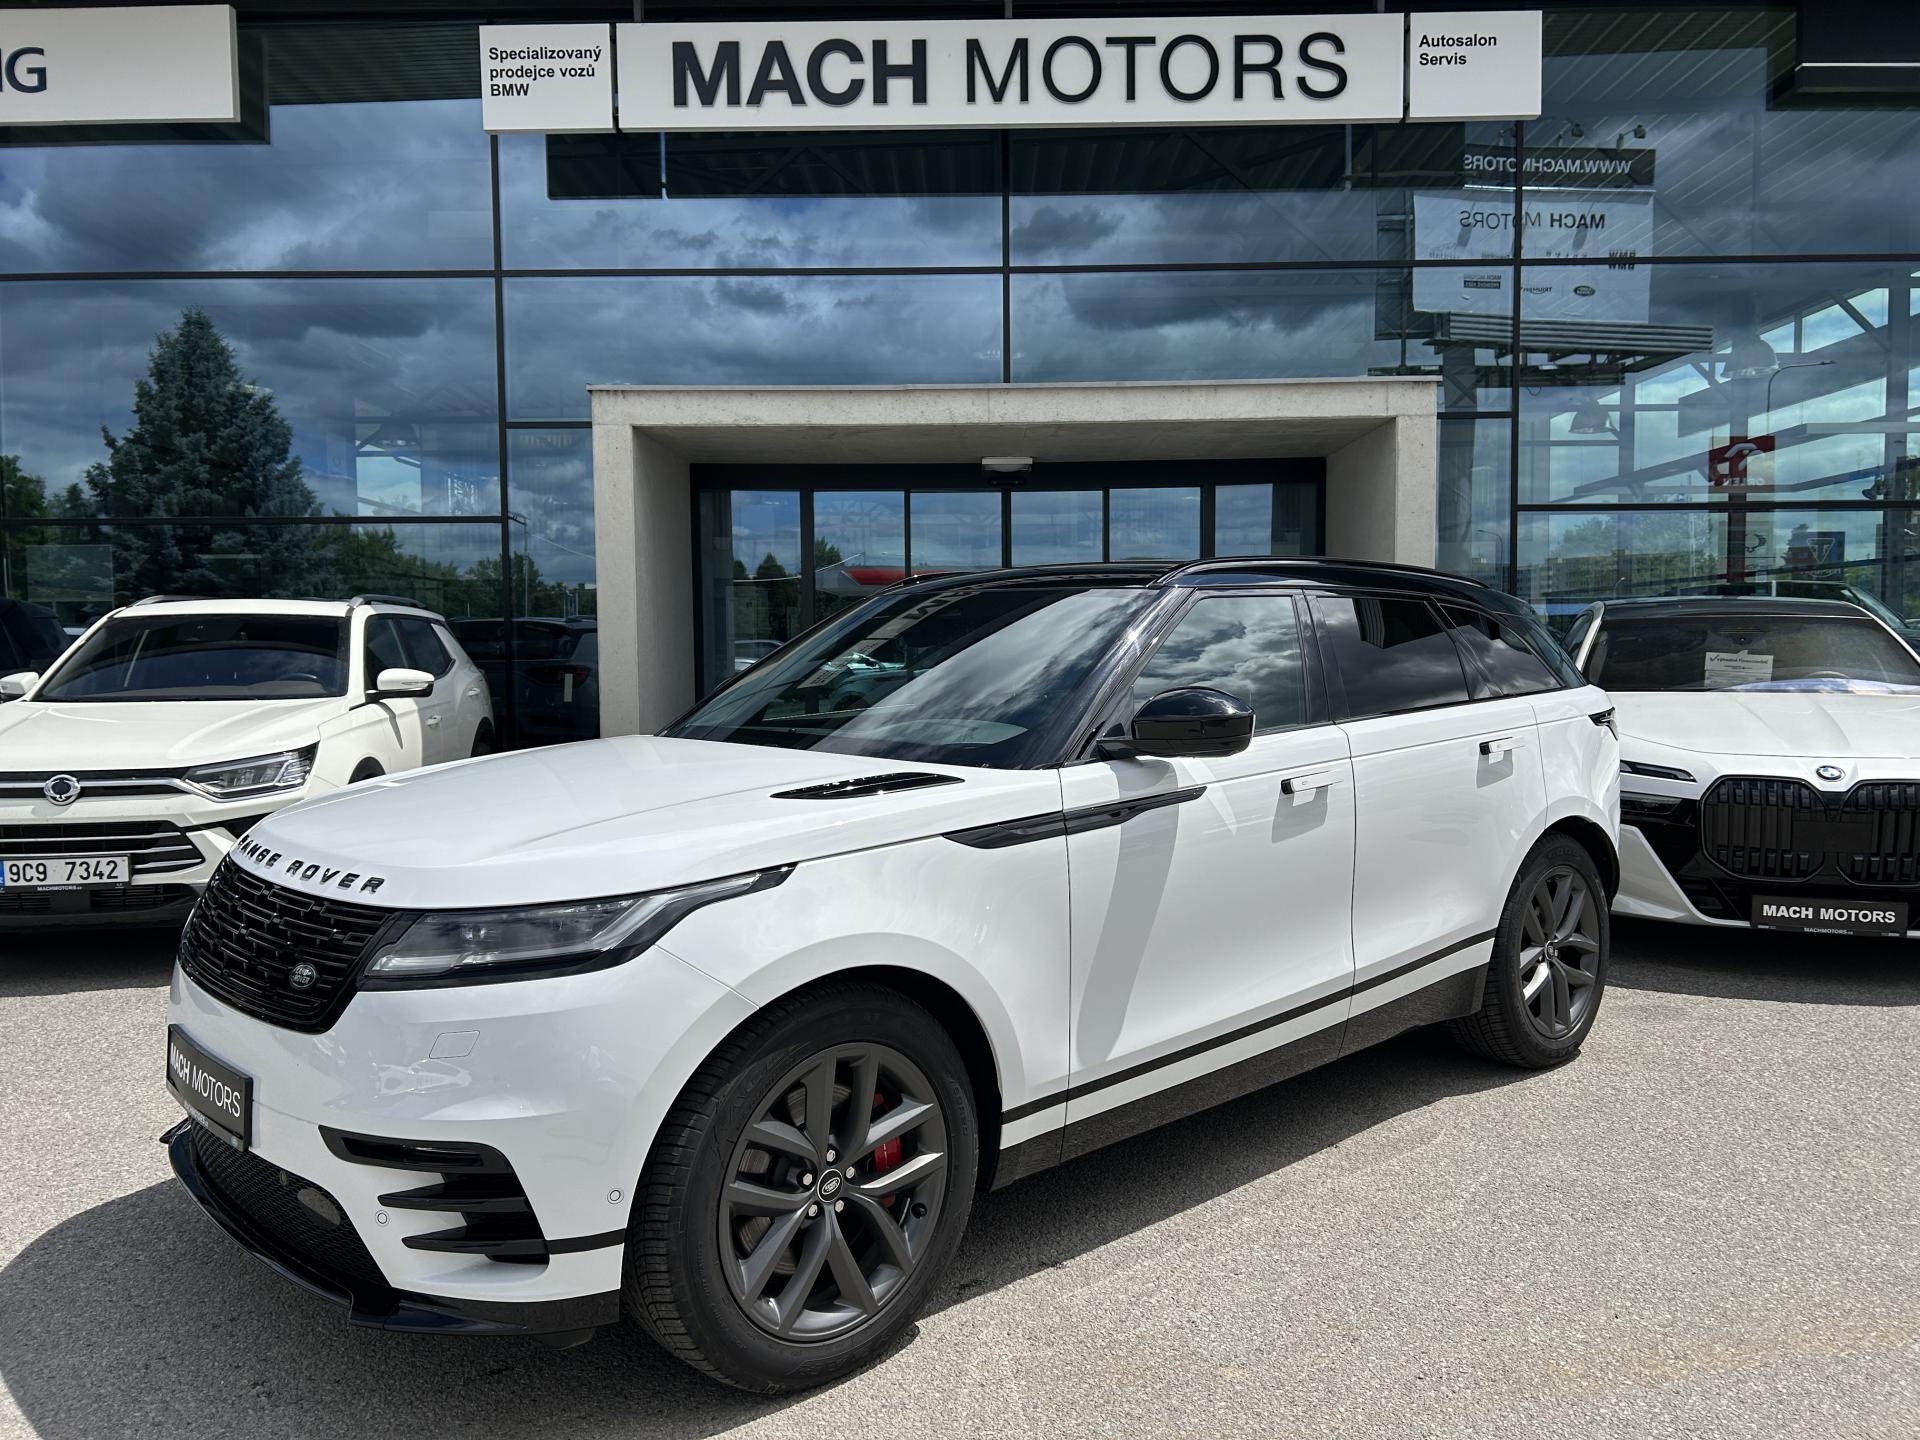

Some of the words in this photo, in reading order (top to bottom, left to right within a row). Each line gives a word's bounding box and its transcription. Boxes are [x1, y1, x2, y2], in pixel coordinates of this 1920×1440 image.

[1419, 33, 1497, 48] Autosalon
[489, 46, 602, 62] Specializovaný
[1419, 52, 1467, 66] Servis
[0, 46, 47, 93] G
[490, 65, 555, 81] prodejce
[559, 64, 595, 77] vozů
[672, 38, 928, 107] MACH
[966, 32, 1348, 104] MOTORS
[490, 83, 529, 96] BMW
[9, 863, 47, 883] 9C9
[65, 860, 119, 881] 7342
[284, 859, 385, 894] ROVER
[1762, 904, 1813, 919] MACH
[1819, 907, 1896, 923] MOTORS
[169, 1042, 191, 1085] MACH
[191, 1065, 241, 1118] MOTORS
